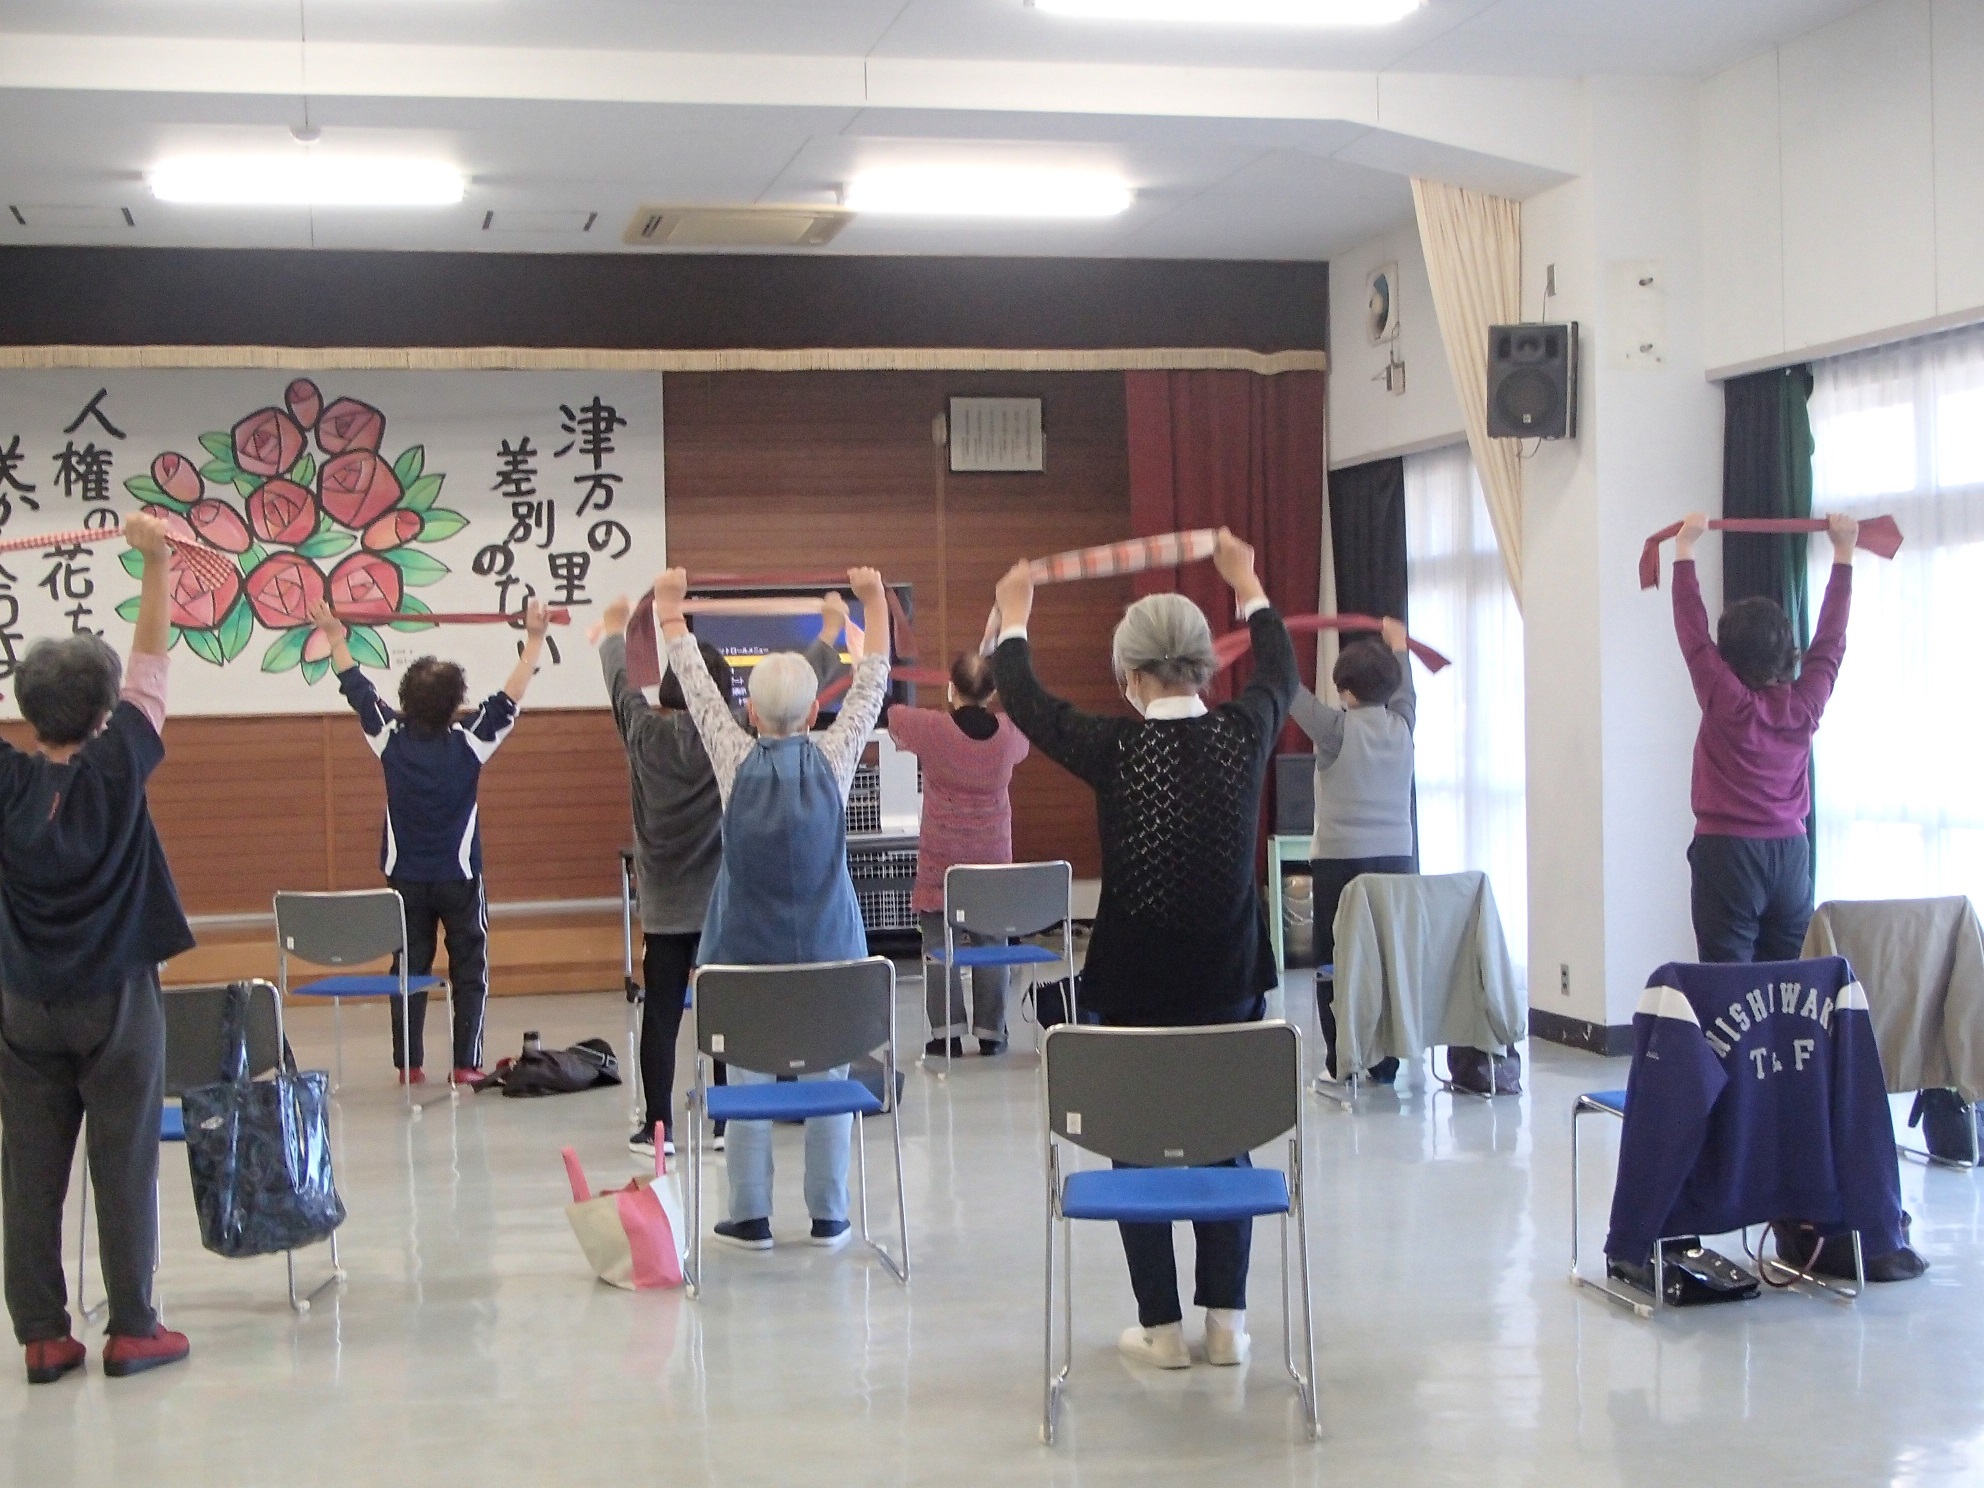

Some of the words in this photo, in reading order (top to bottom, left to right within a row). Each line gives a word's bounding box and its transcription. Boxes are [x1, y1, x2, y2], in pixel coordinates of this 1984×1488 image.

[548, 396, 632, 606] 津万の里
[1750, 1048, 1766, 1079] T
[1793, 1039, 1815, 1071] F
